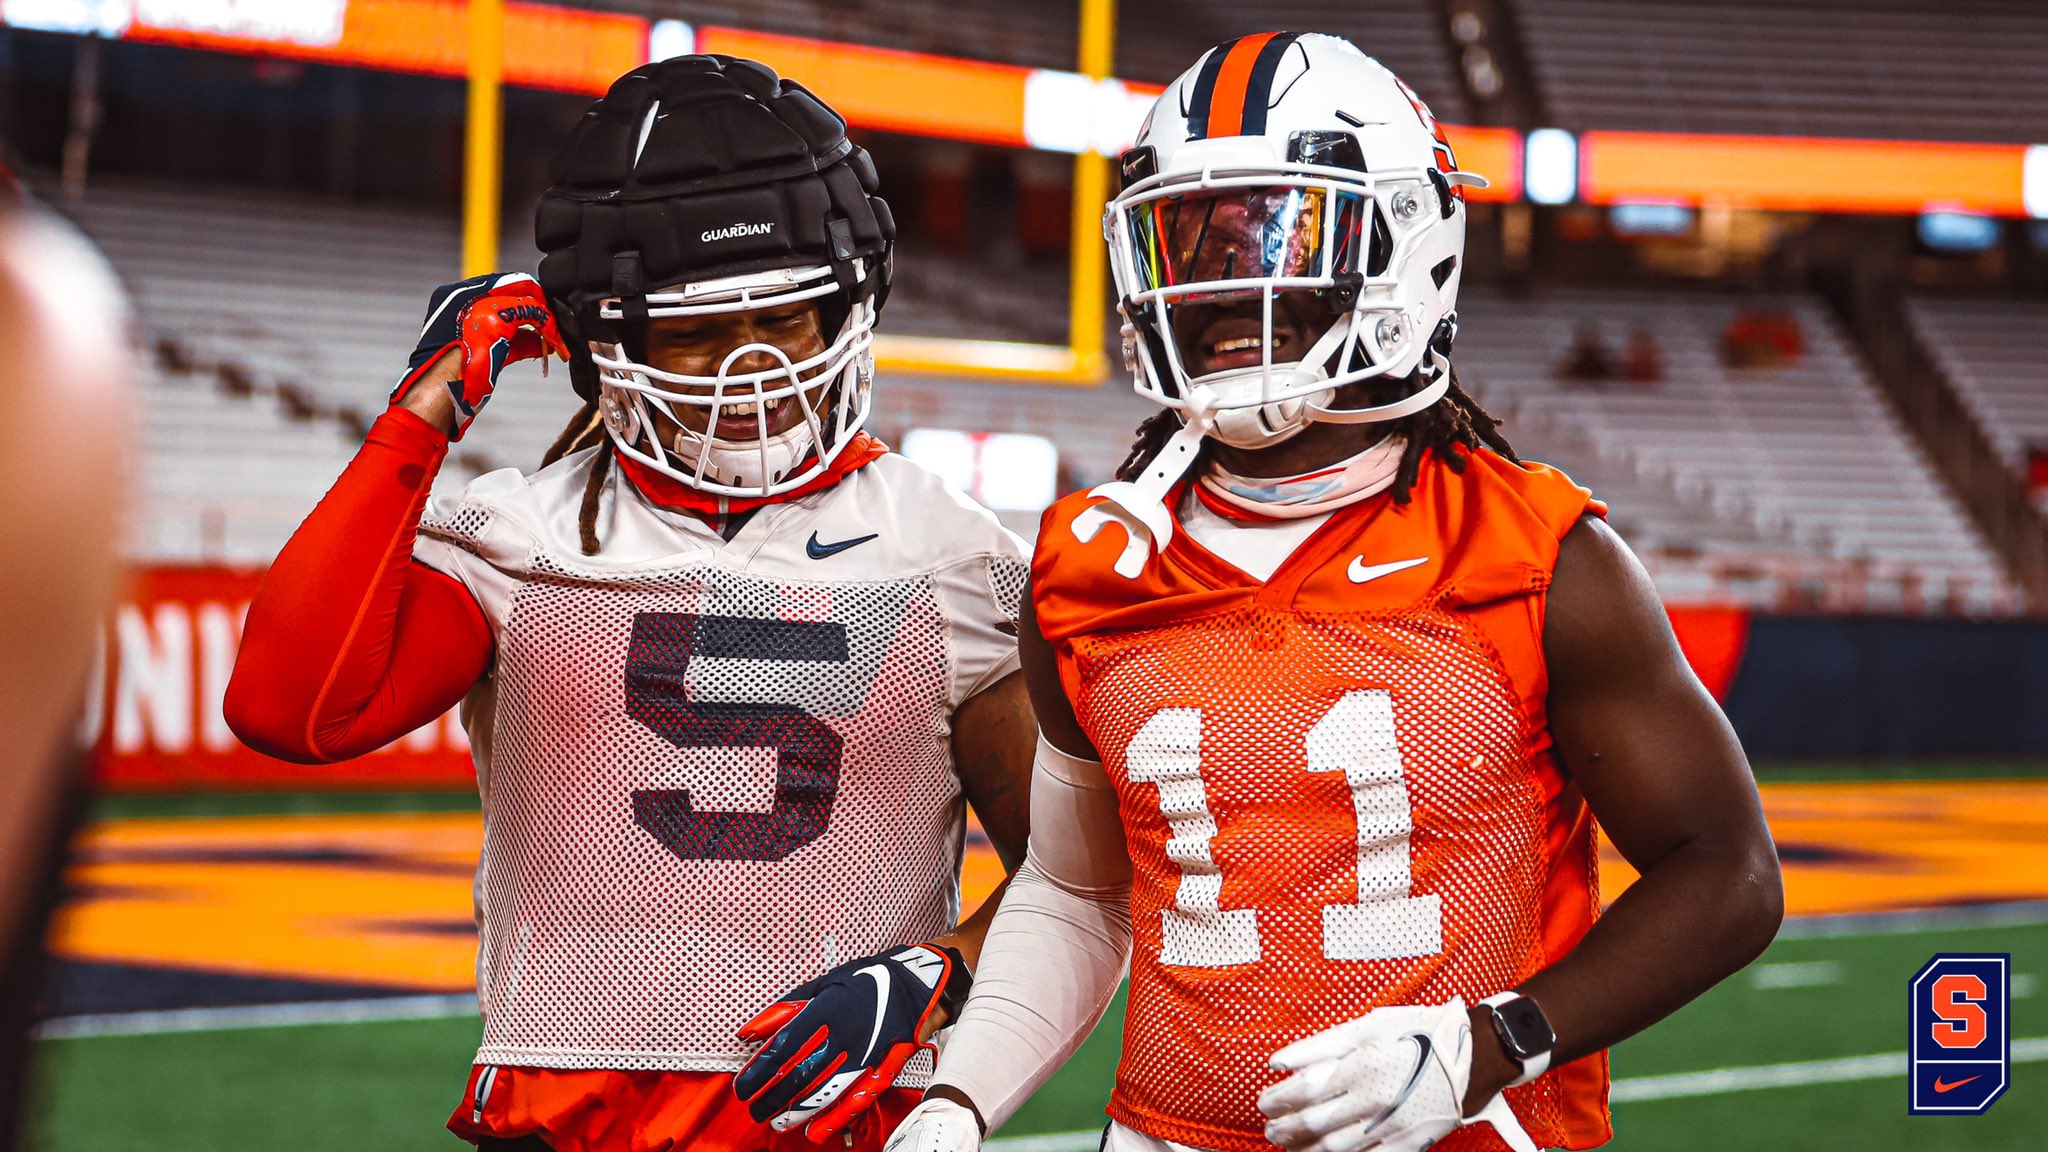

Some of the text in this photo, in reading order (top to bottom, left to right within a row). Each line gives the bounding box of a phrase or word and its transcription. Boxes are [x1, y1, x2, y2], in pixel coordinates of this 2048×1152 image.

[701, 223, 772, 243] GUARDIAN
[498, 305, 549, 324] ORANGE
[624, 612, 850, 862] 5
[1125, 688, 1443, 967] 11
